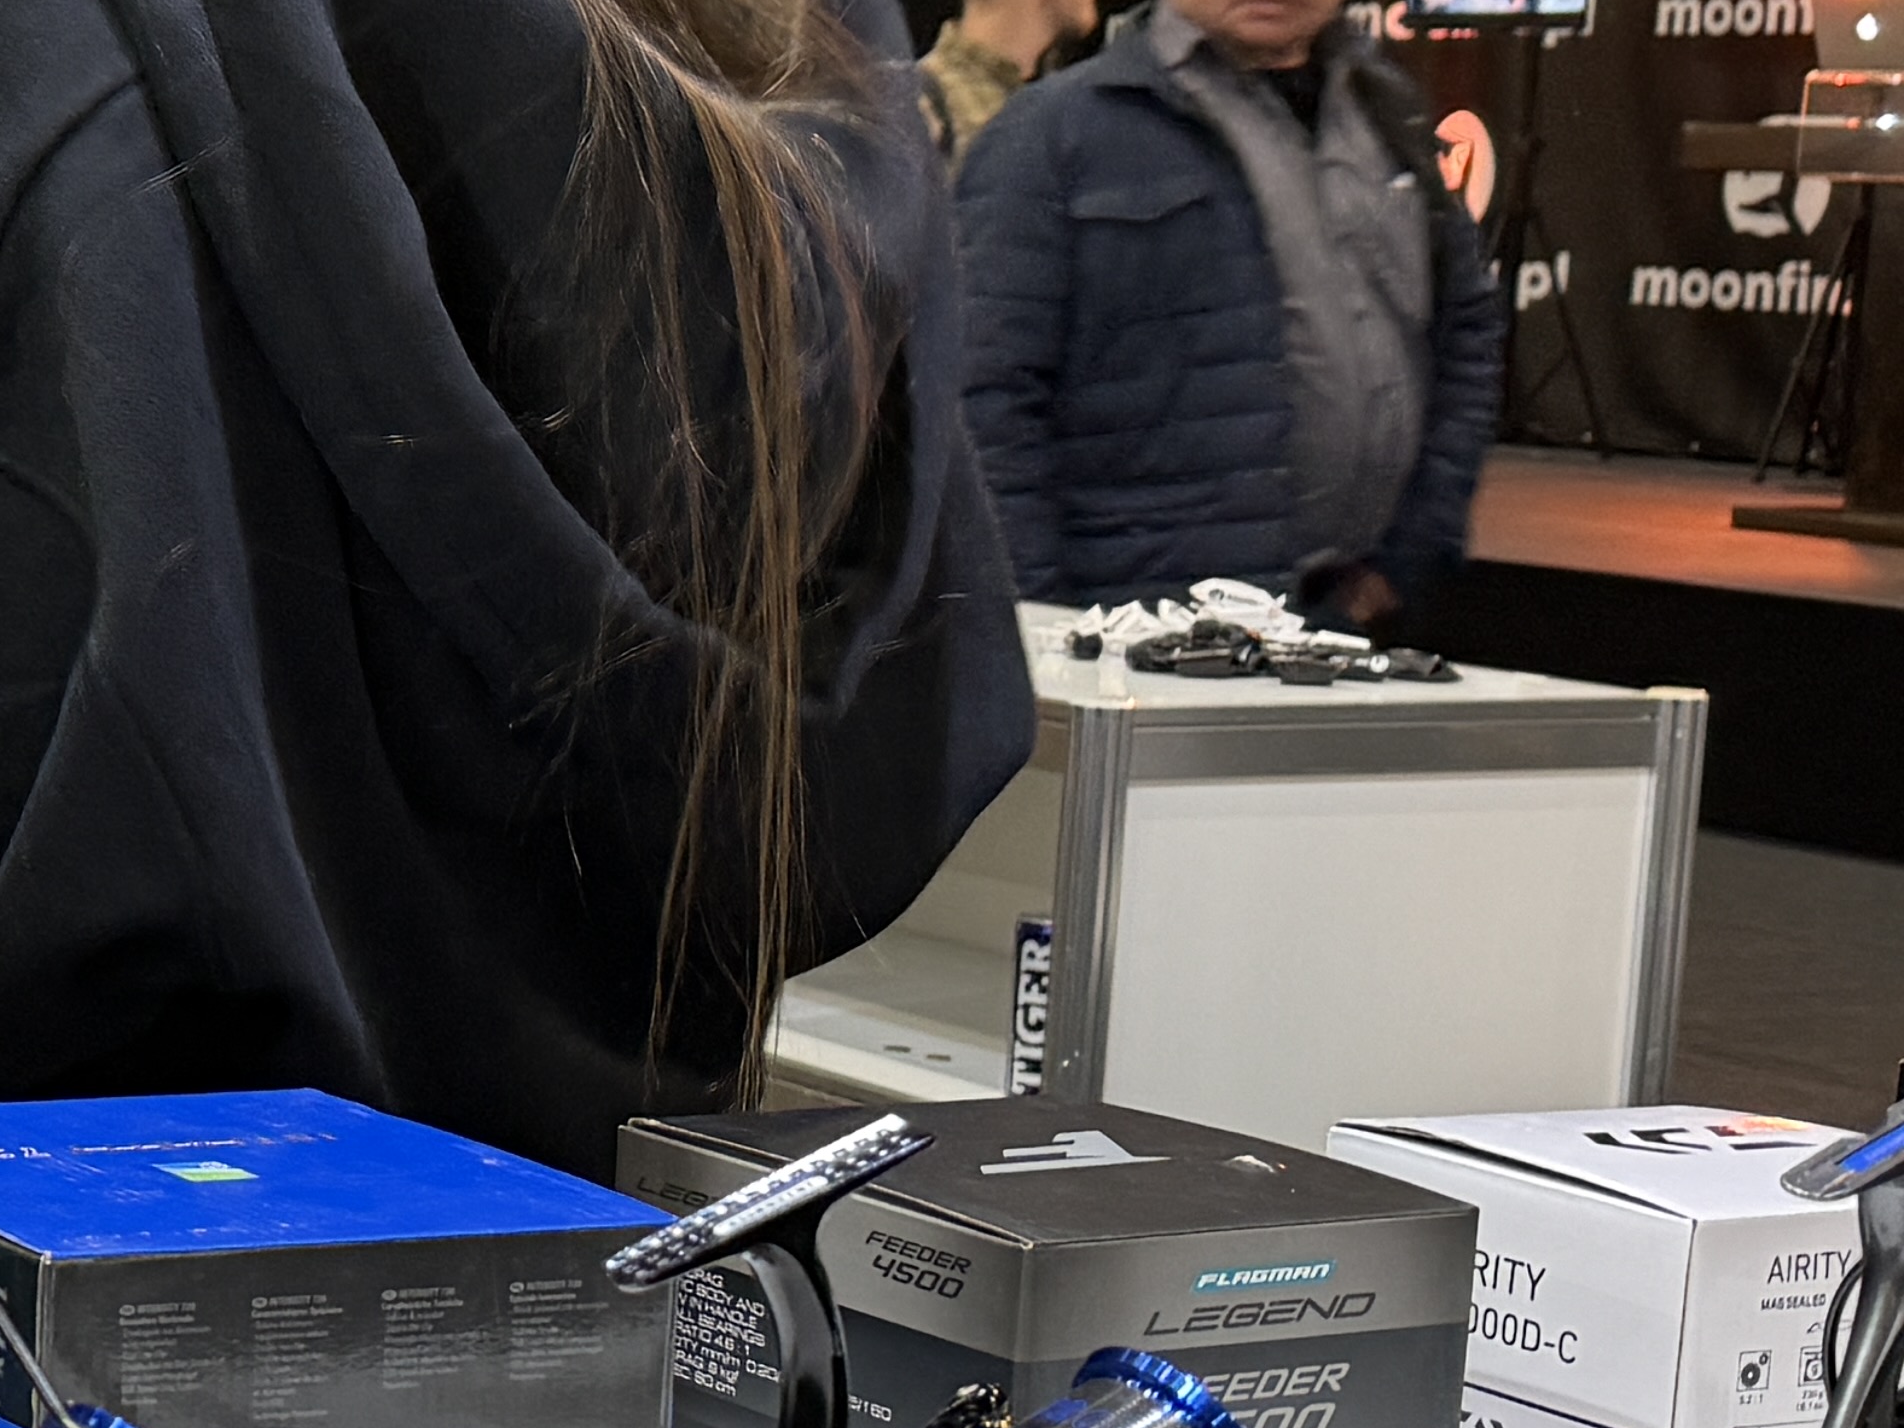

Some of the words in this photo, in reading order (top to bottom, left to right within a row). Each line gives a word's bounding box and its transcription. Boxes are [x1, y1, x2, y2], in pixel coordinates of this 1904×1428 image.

[1011, 936, 1052, 1097] TIGER
[865, 1228, 973, 1275] FEEDER
[1766, 1249, 1852, 1285] AIRITY
[872, 1254, 966, 1300] 4500
[1196, 1261, 1332, 1291] FLAGMAN
[1143, 1291, 1377, 1337] LEGEND
[1205, 1362, 1351, 1405] EEDER
